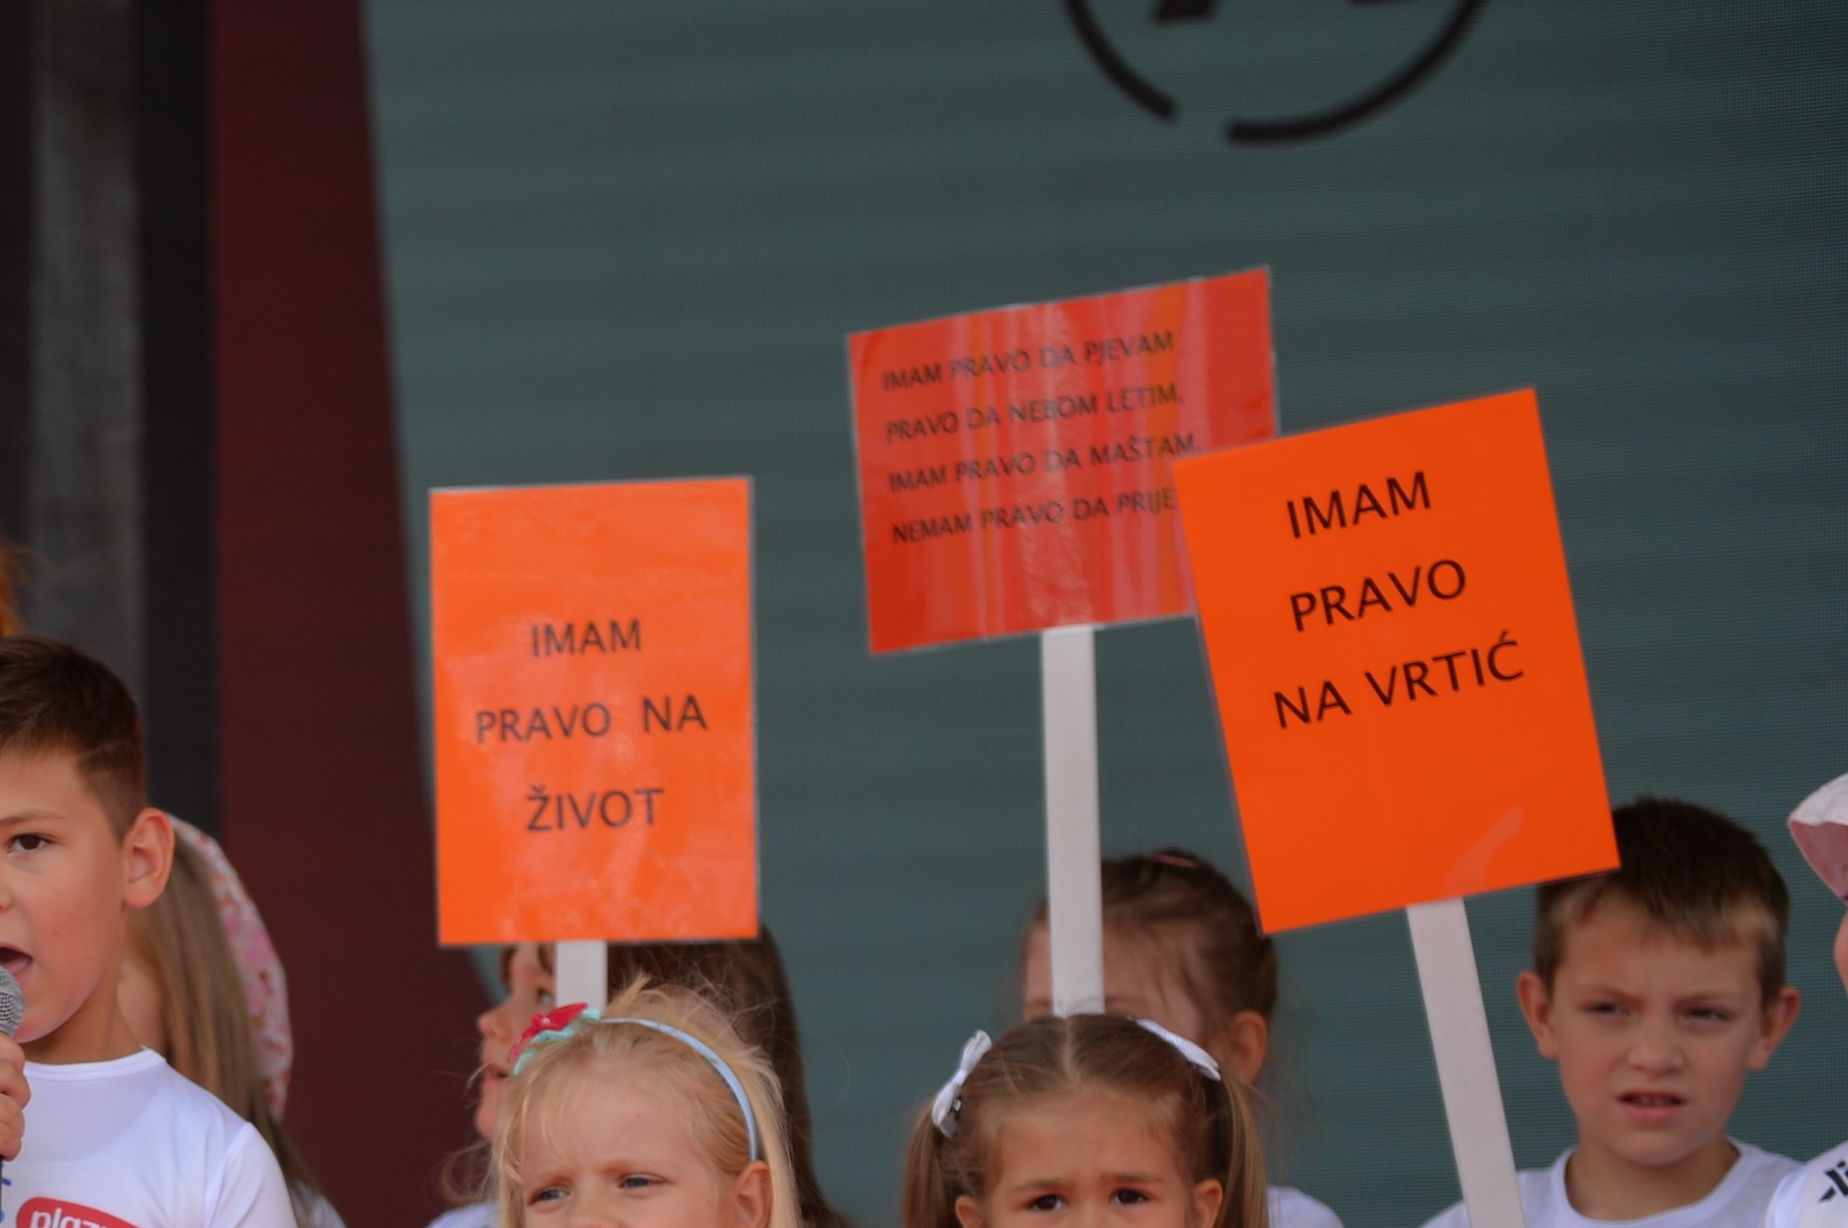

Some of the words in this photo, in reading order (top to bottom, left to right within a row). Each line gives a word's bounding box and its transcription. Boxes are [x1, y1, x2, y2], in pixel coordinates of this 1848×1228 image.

[883, 363, 943, 393] IMAM
[950, 350, 1032, 379] PRAVO
[1039, 344, 1076, 370] DA
[886, 411, 959, 443] PRAVO
[966, 405, 1001, 430] DA
[1008, 394, 1099, 426] NEBOM
[889, 466, 948, 495] IMAM
[955, 454, 1036, 484] PRAVO
[1045, 446, 1082, 473] DA
[892, 514, 973, 545] NEMAM
[981, 502, 1065, 533] PRAVO
[1073, 496, 1111, 523] DA
[1117, 487, 1176, 517] PRIJE
[1286, 470, 1432, 539] IMAM
[1289, 558, 1467, 633] PRAVO
[530, 618, 642, 658] IMAM
[1273, 680, 1353, 730] NA
[1364, 629, 1525, 708] VRTIĆ
[475, 702, 611, 744] PRAVO
[640, 694, 709, 734] NA
[525, 785, 665, 834] ŽIVOT
